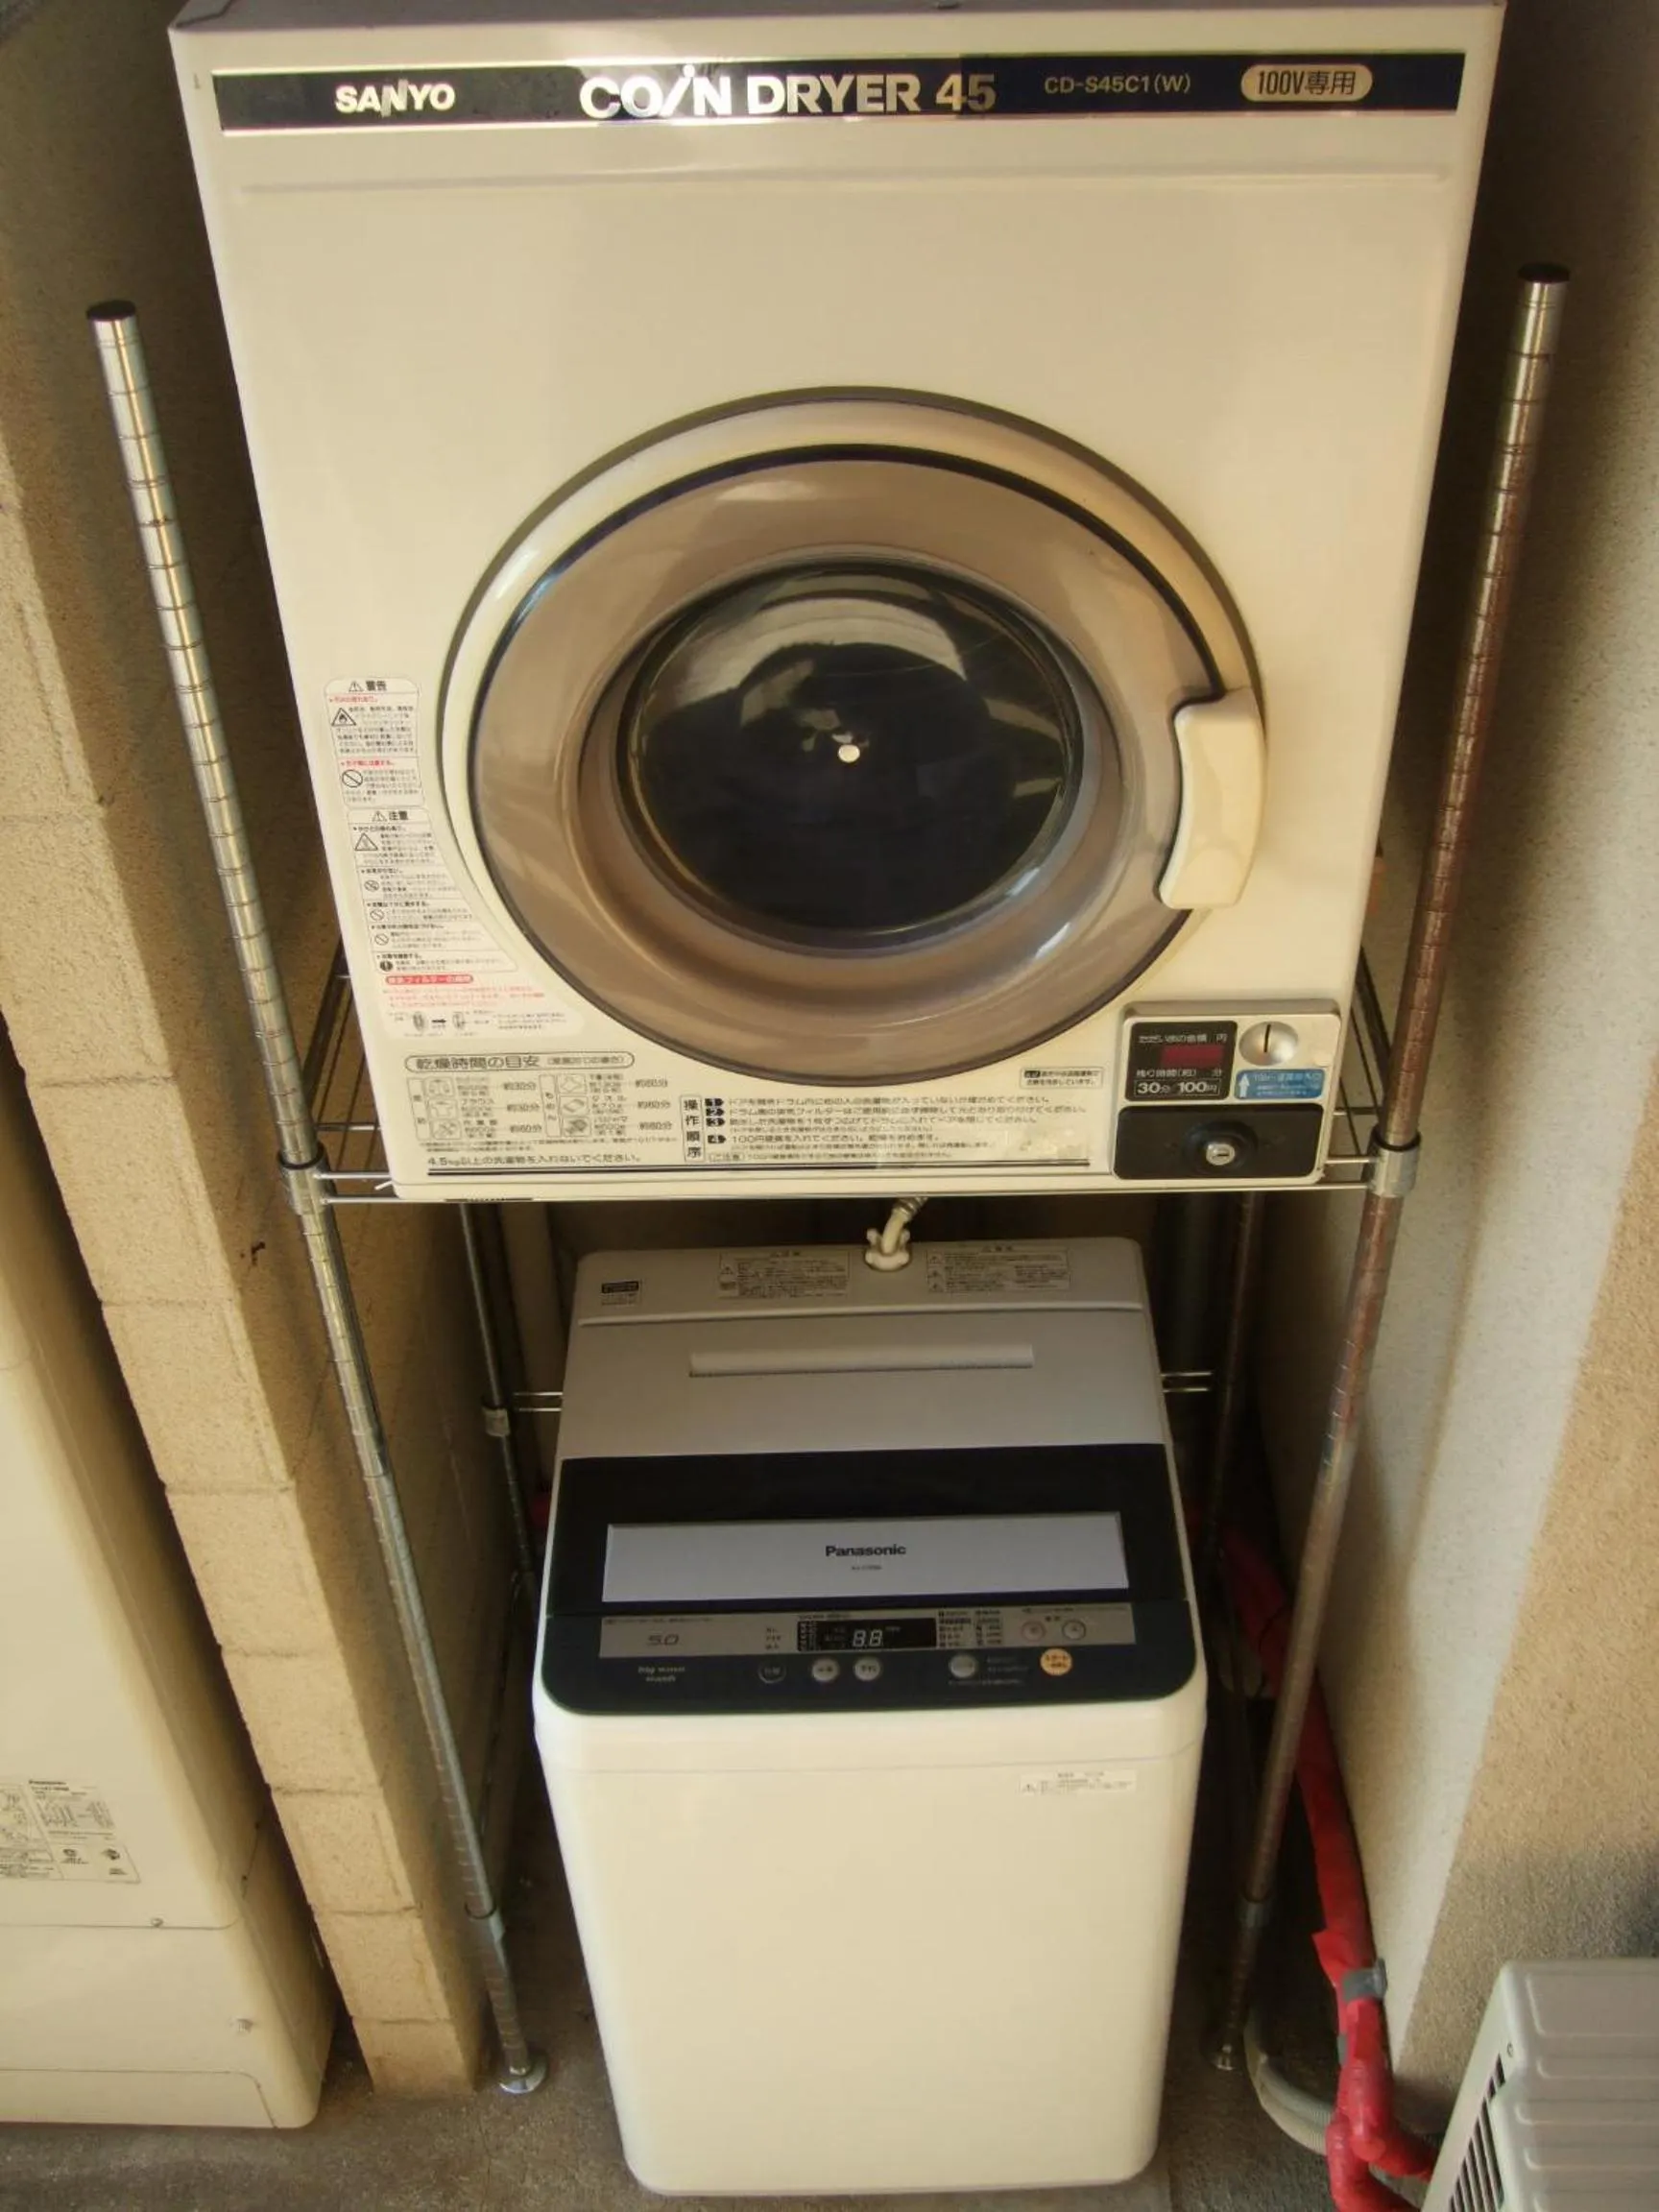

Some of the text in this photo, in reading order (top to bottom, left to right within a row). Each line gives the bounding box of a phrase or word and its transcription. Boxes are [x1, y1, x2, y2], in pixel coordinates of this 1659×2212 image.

[579, 63, 997, 119] COIN DRYER 45
[1045, 72, 1191, 95] CD-S45C1(W)
[1258, 69, 1357, 96] 100V専用
[334, 79, 455, 116] SANYO
[417, 1055, 540, 1070] 乾燥時間の目安
[825, 1543, 906, 1557] Panasonic
